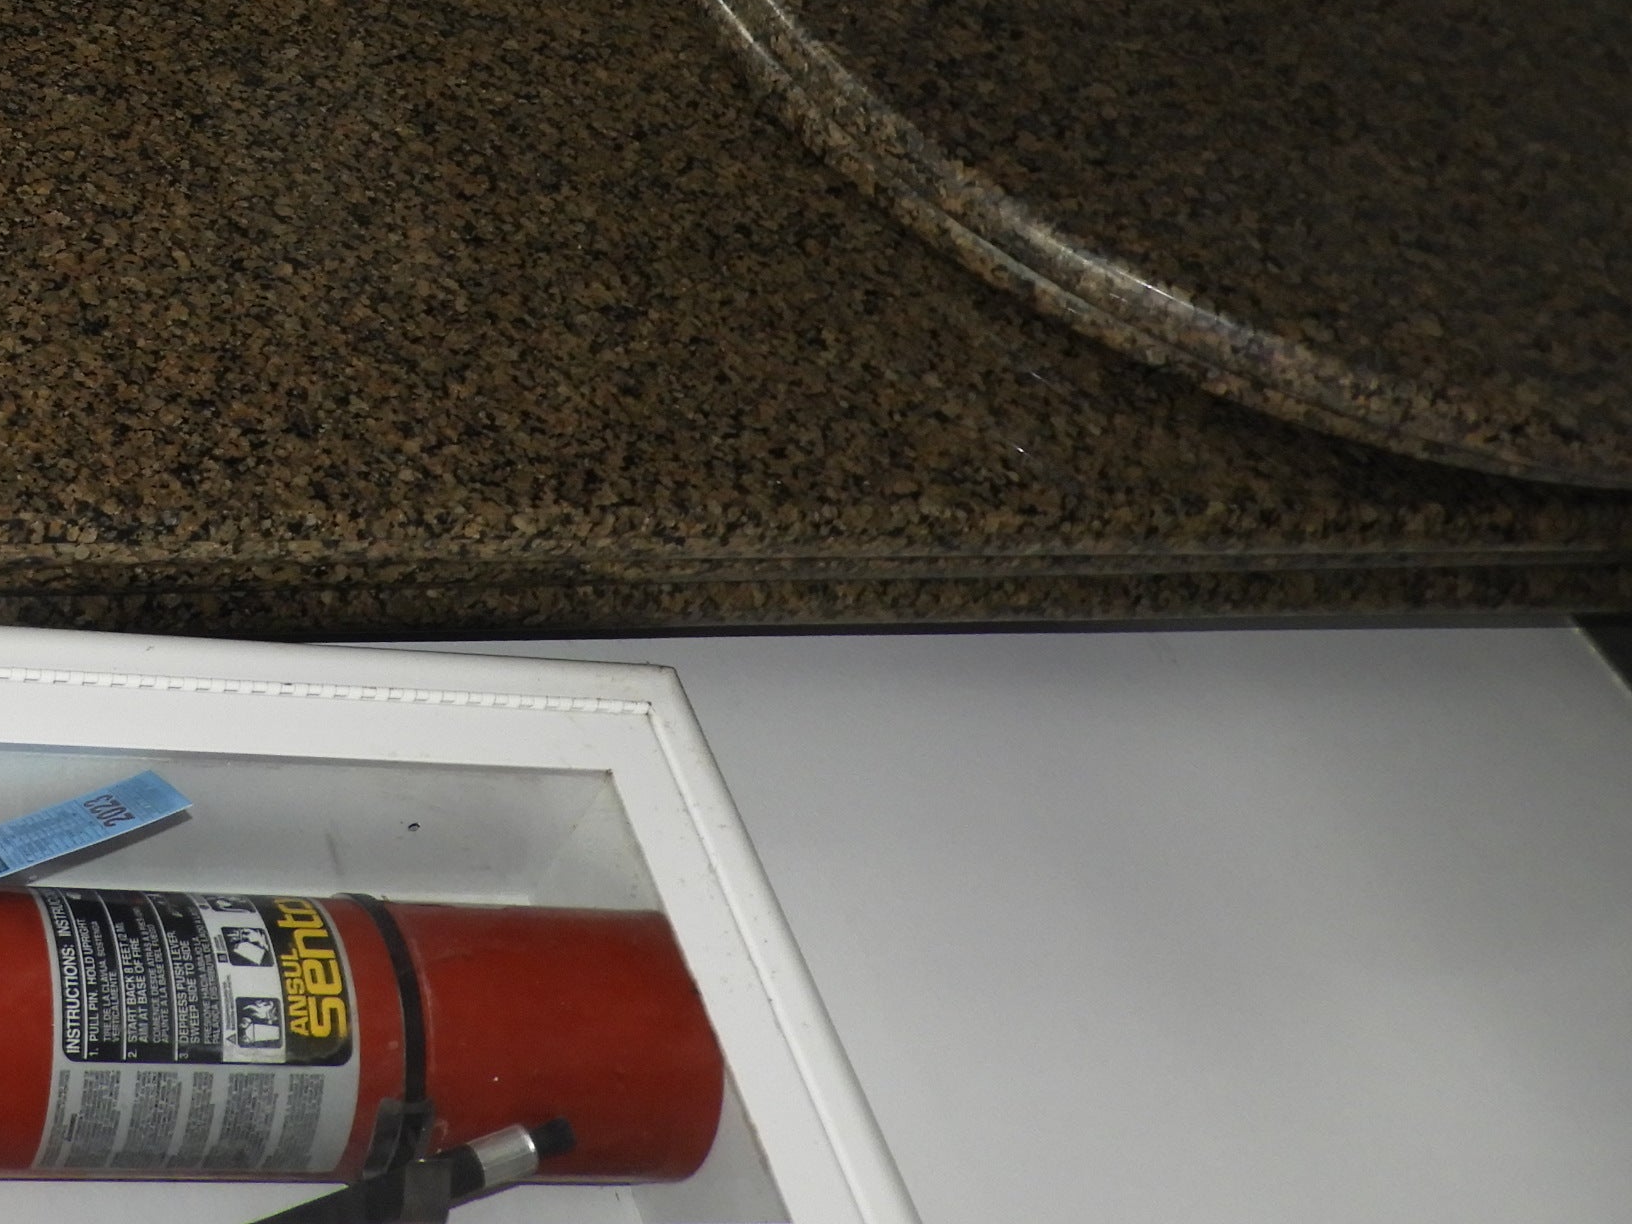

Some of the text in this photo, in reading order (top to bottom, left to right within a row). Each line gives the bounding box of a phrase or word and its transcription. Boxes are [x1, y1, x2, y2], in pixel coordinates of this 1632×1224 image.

[83, 794, 136, 828] 2023
[76, 919, 94, 955] UPRIGHT
[120, 943, 133, 967] FEET
[84, 957, 98, 985] HOLD
[173, 962, 185, 990] PUSH
[61, 944, 81, 1053] INSTRUCTIONS:
[87, 990, 99, 1011] PIN.
[101, 995, 111, 1006] LA
[125, 975, 137, 1006] BACK
[130, 937, 149, 1043] AIM AT BASE OF FIRE
[179, 939, 201, 1044] SWEEP SIDE TO SIDE
[278, 947, 309, 1037] ANSUL
[88, 1014, 100, 1042] PULL
[102, 1009, 111, 1020] DE
[127, 1008, 138, 1043] START
[176, 992, 190, 1044] DEPRESS
[103, 1022, 113, 1042] TIRE
